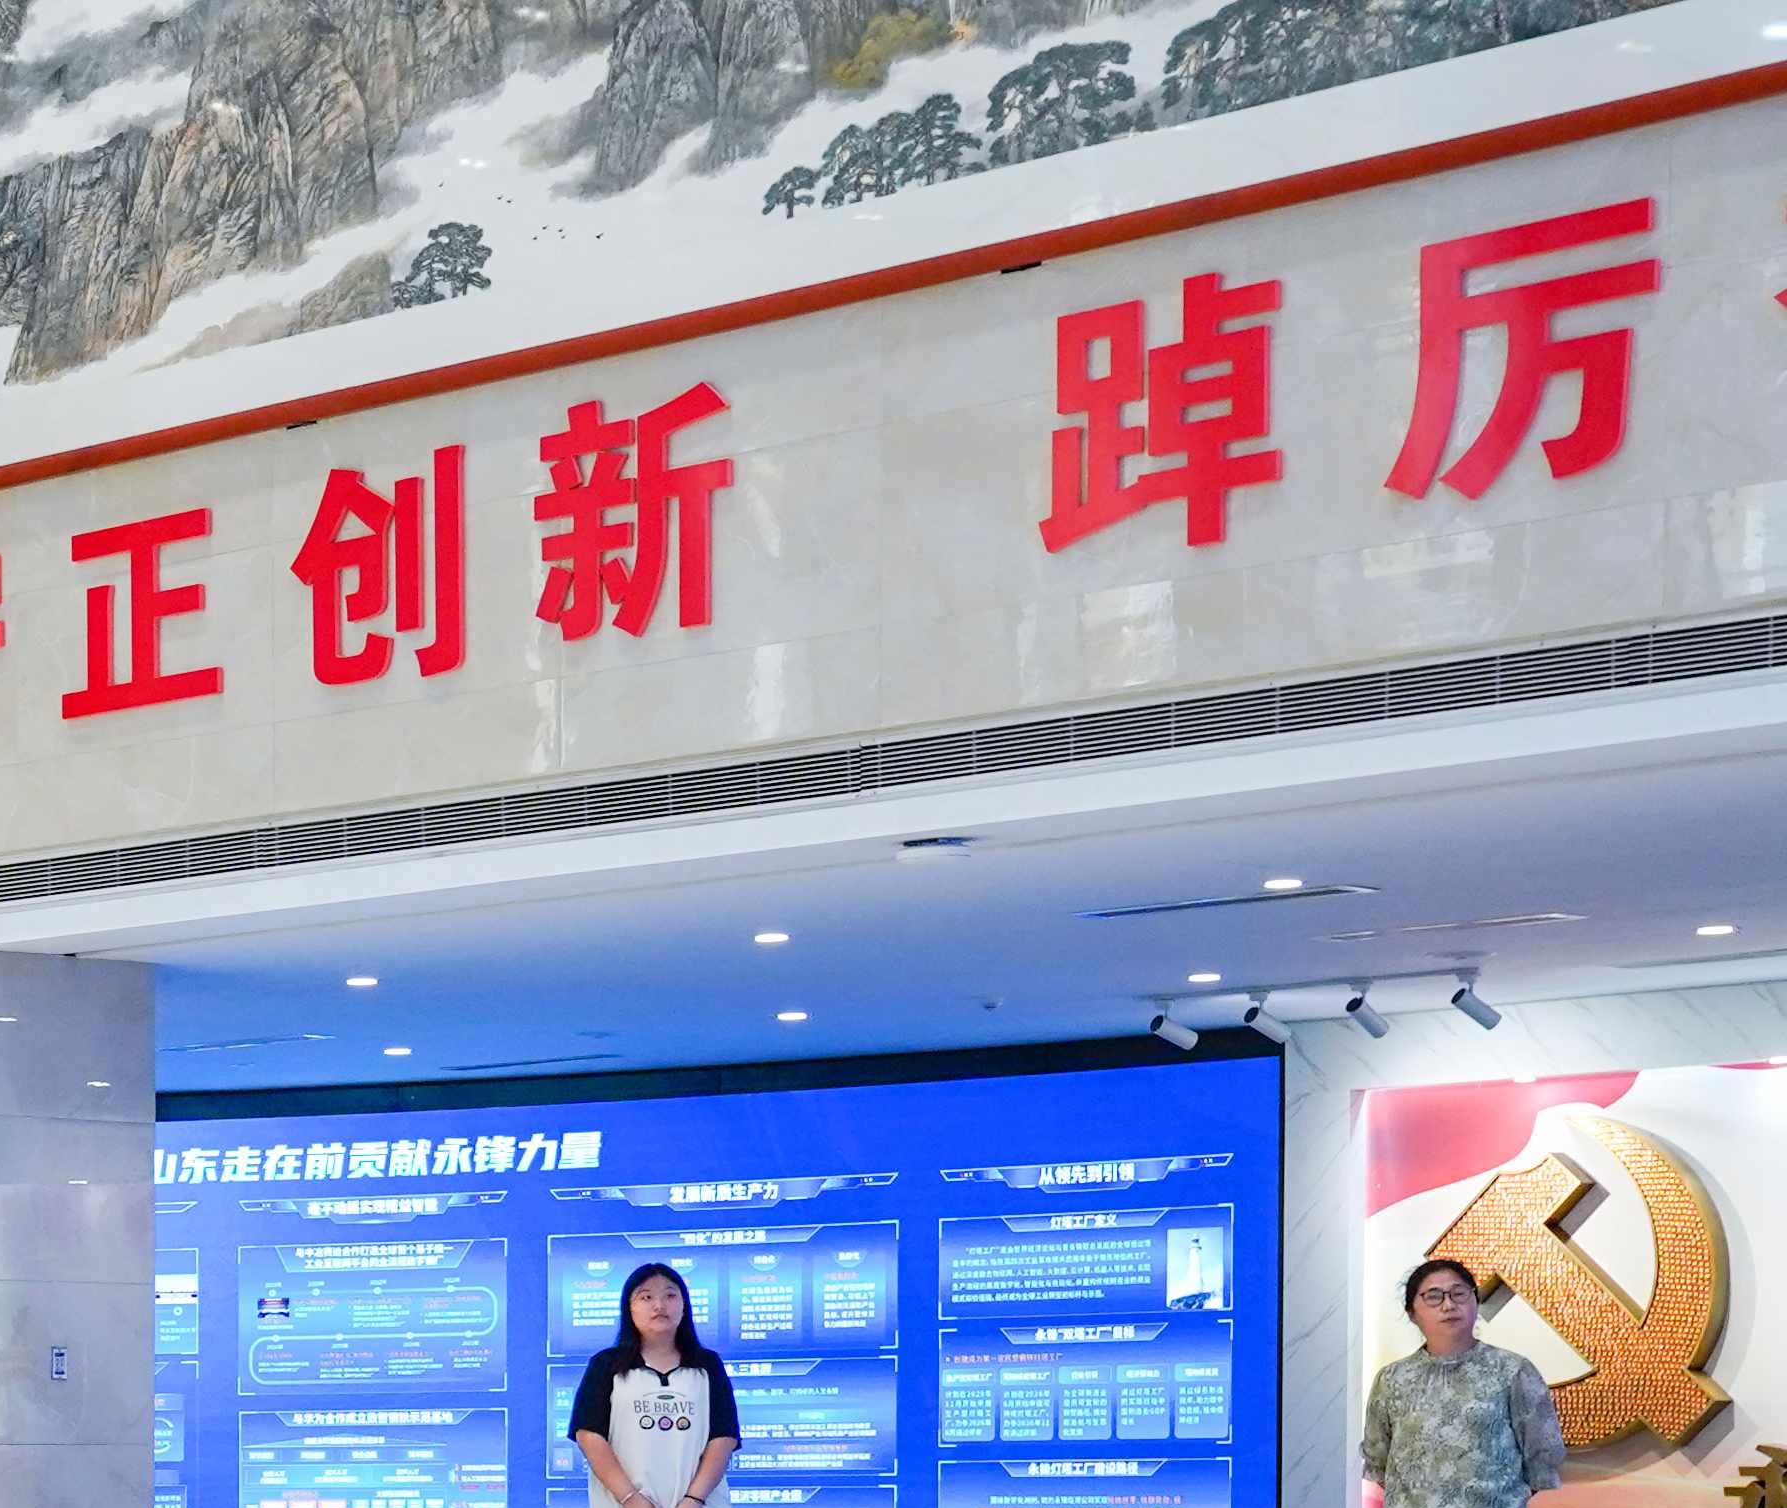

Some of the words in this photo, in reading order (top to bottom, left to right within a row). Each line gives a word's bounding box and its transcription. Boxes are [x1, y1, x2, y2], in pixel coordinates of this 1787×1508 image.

[1040, 200, 1787, 551] 踔厉
[154, 1131, 603, 1184] 山东走在前贡献永锋力量
[1039, 1163, 1135, 1185] 从领先到引领
[669, 1184, 779, 1203] 发展新质生产力
[1050, 1214, 1118, 1229] 灯塔工厂定义
[633, 1400, 650, 1413] BE
[653, 1400, 696, 1415] BRAVE
